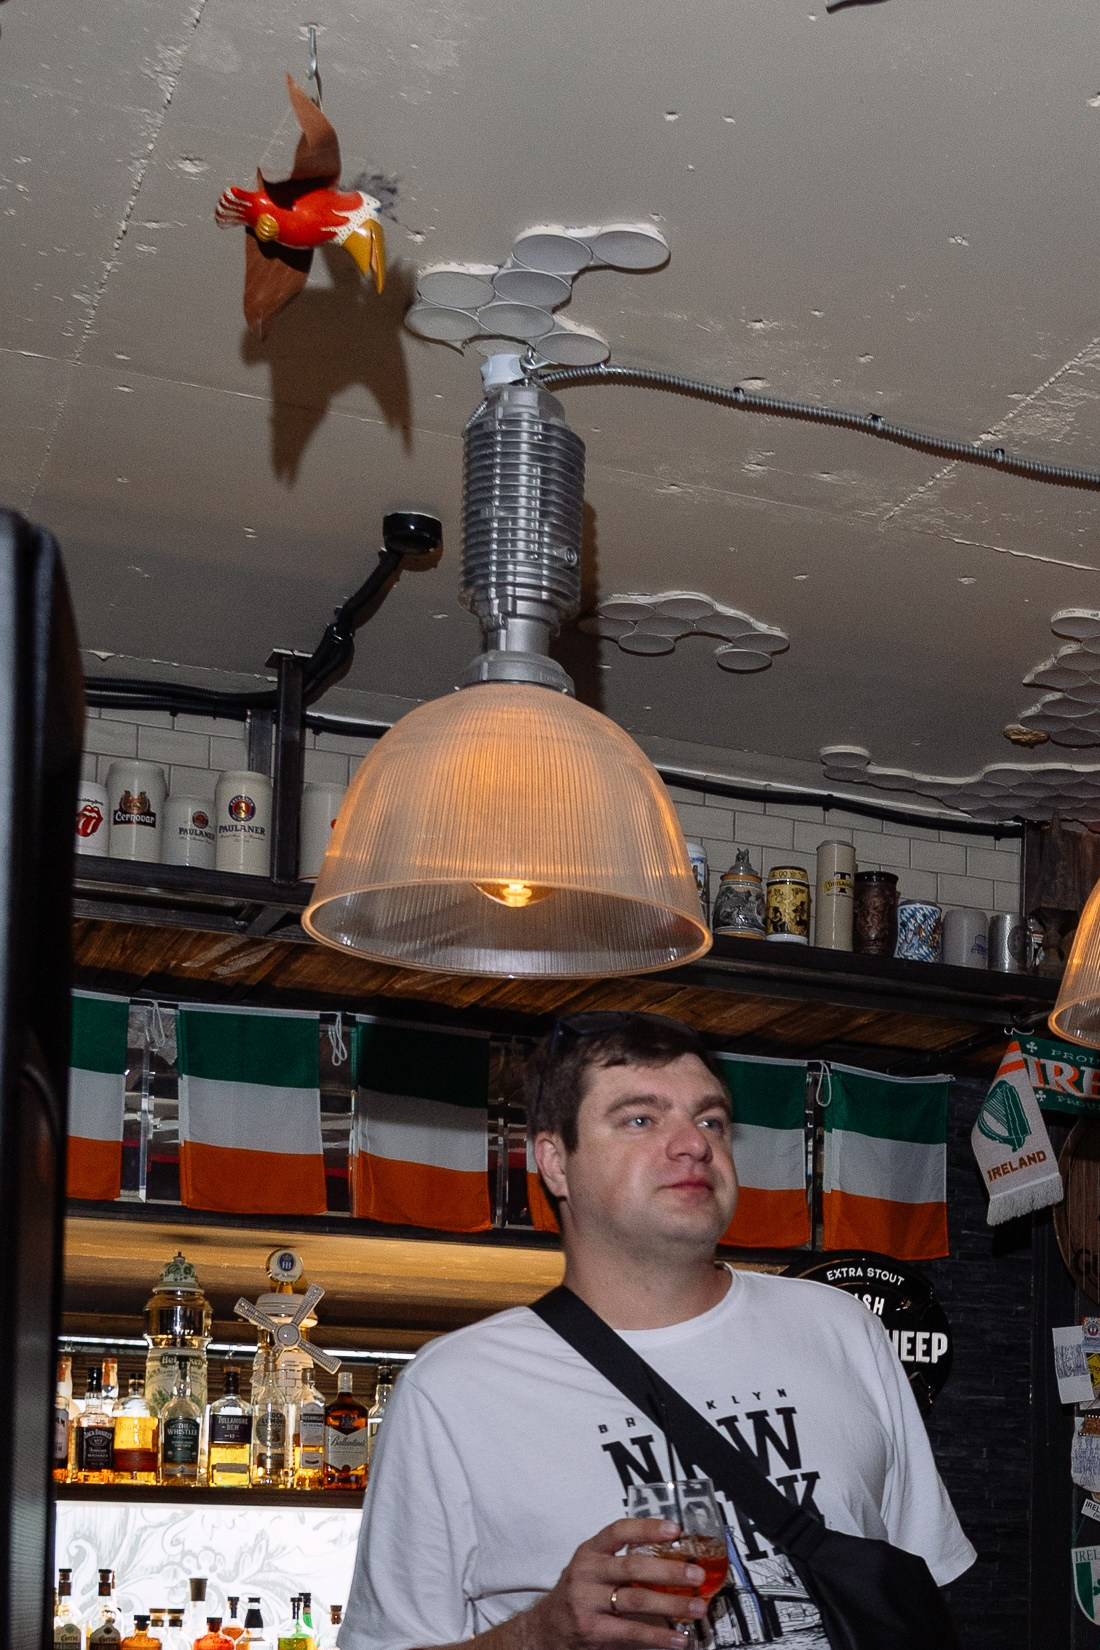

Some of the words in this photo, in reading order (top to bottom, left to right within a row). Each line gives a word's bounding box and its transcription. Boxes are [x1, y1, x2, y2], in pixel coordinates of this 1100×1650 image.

[179, 826, 215, 842] PAULANER
[218, 825, 266, 837] PAULANER
[987, 1150, 1047, 1182] IRELAND
[826, 1267, 864, 1281] EXTRA
[867, 1267, 905, 1286] STOUT
[597, 1388, 788, 1434] BRKLYN
